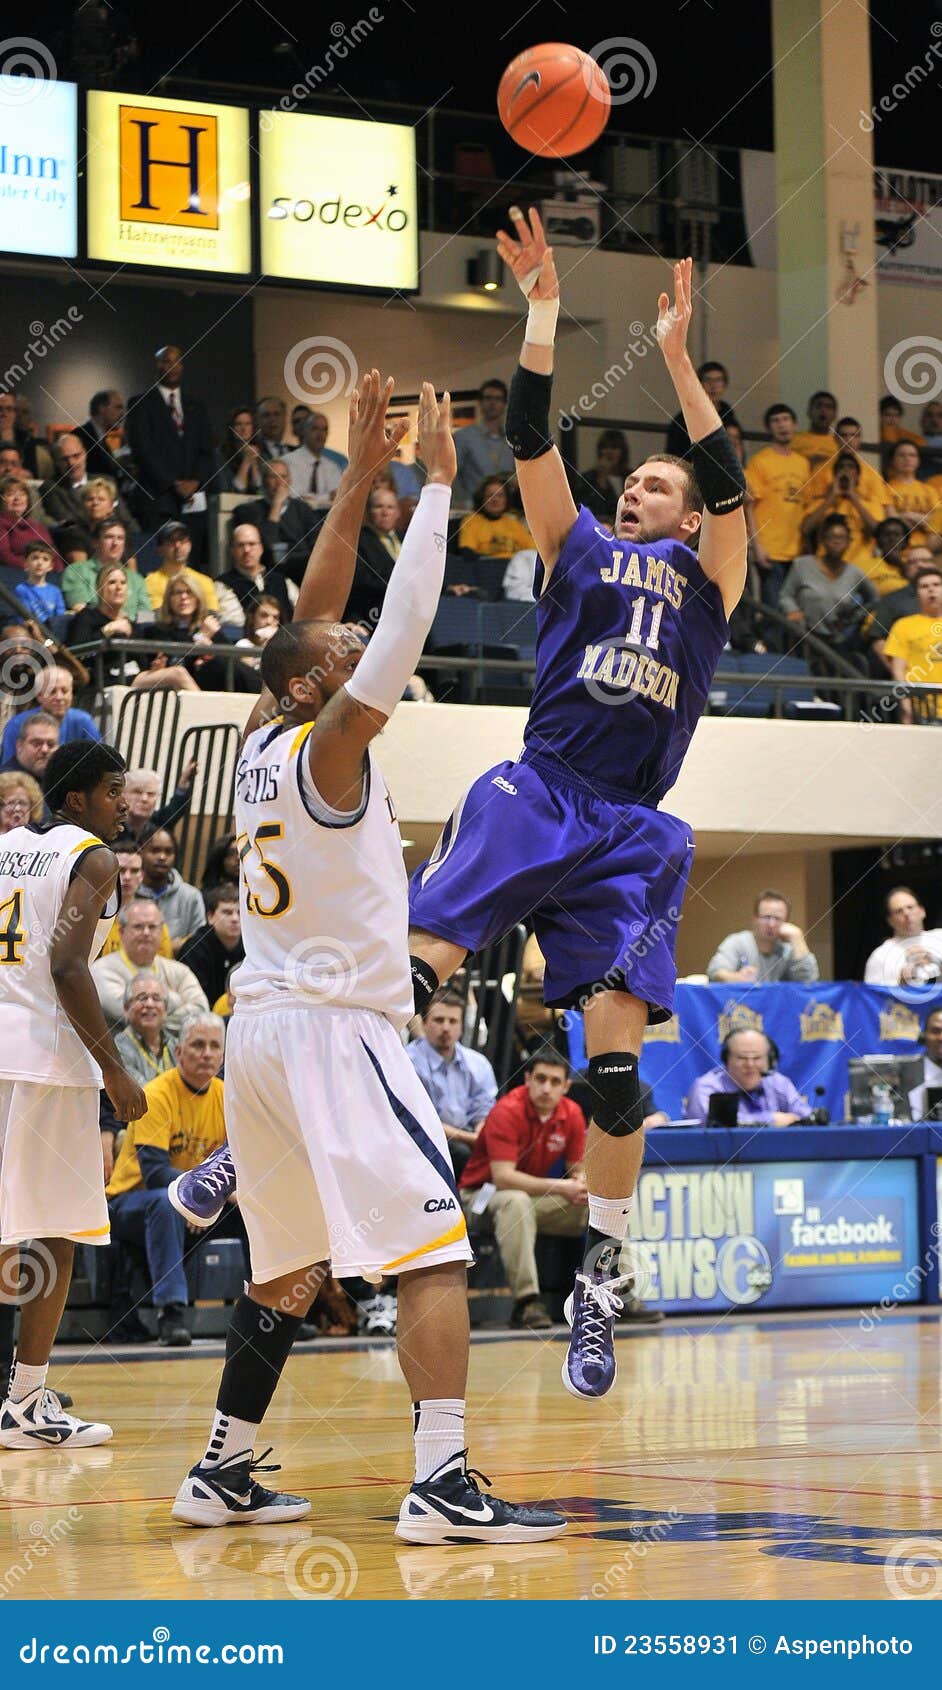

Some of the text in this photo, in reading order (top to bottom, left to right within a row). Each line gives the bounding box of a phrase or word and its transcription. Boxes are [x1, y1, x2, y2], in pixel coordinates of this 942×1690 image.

[0, 145, 58, 179] Inn
[129, 119, 209, 216] H
[267, 194, 408, 232] sodexo
[600, 550, 688, 611] JAMES
[625, 595, 665, 651] 11
[577, 644, 680, 711] MADISON
[423, 1198, 457, 1213] CAA
[791, 1214, 893, 1247] facebook
